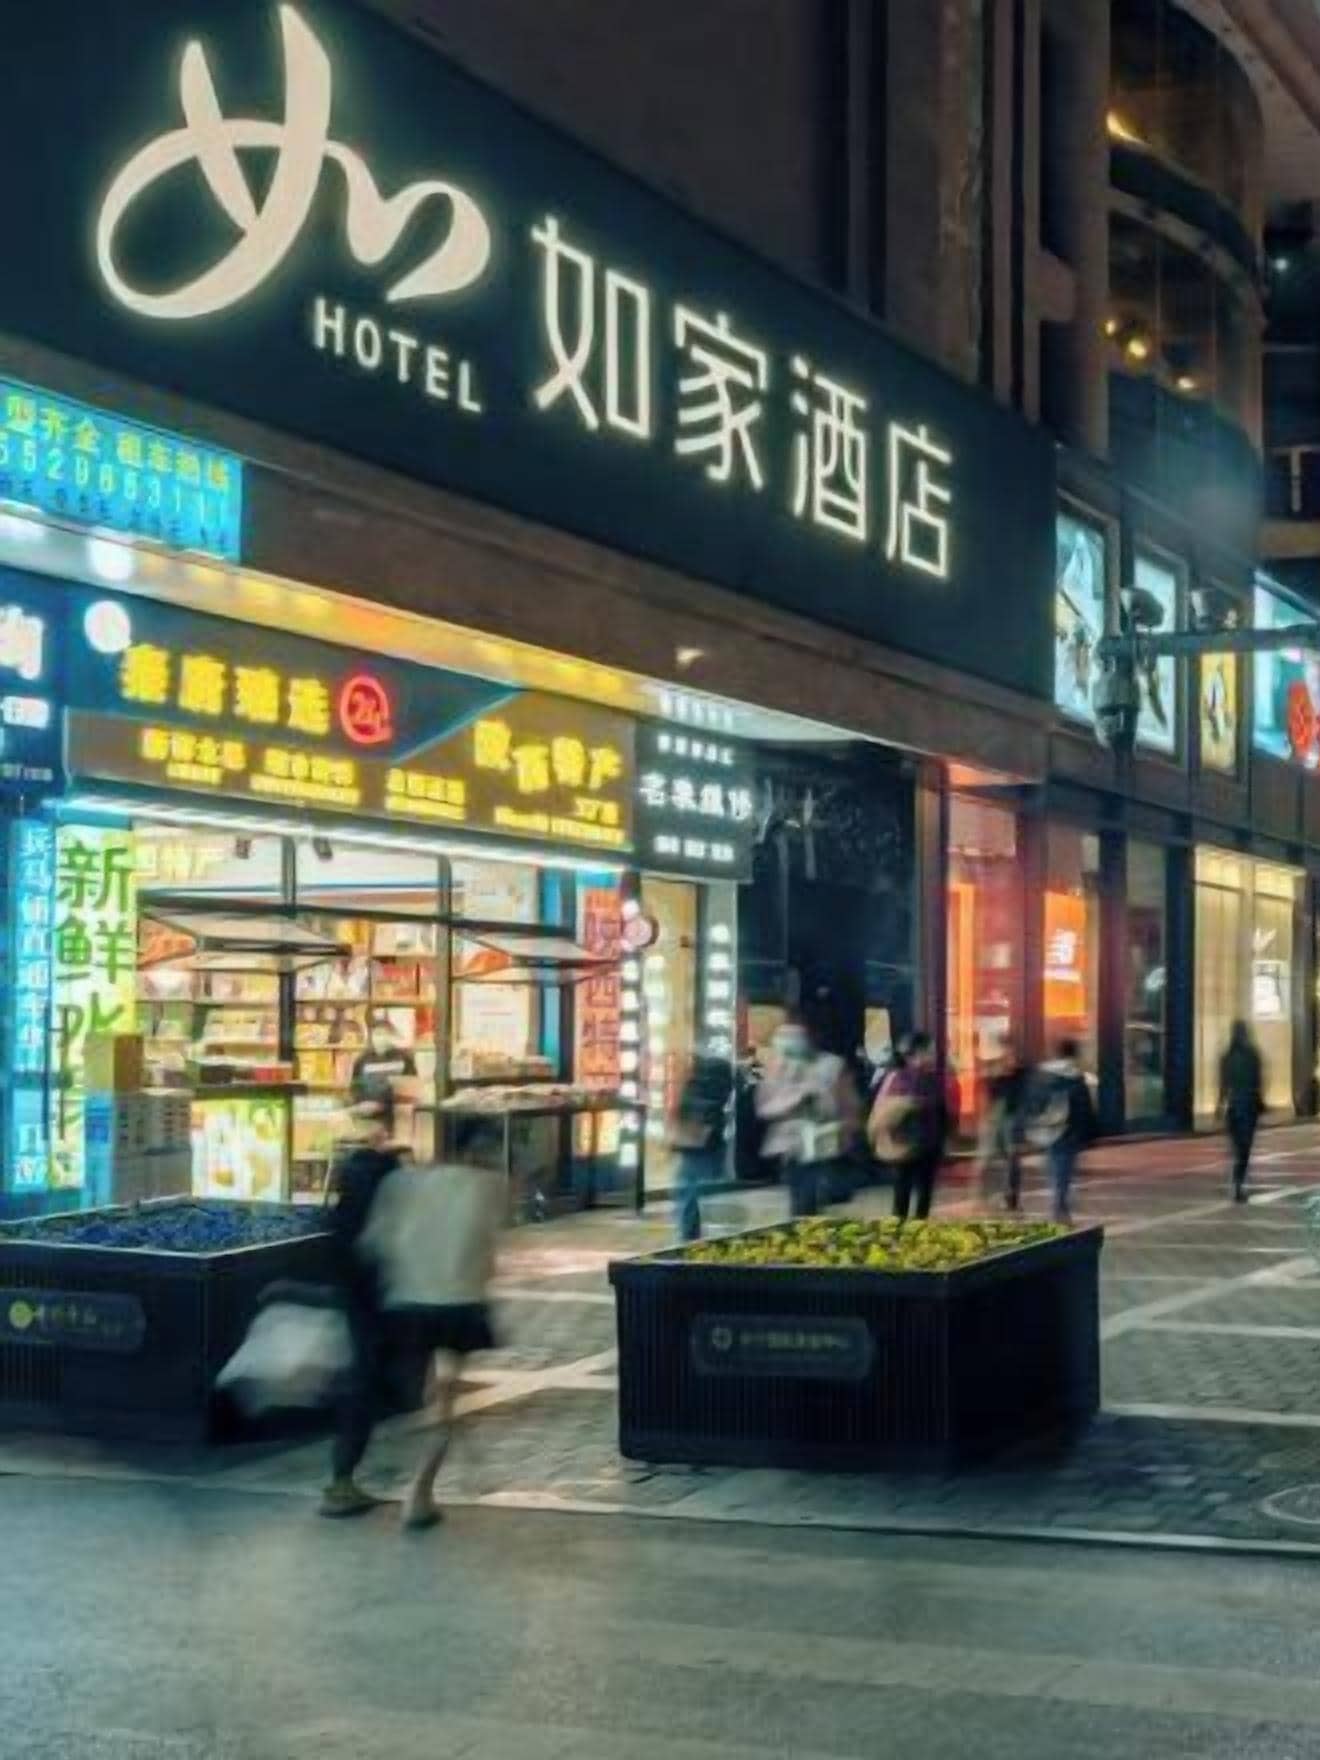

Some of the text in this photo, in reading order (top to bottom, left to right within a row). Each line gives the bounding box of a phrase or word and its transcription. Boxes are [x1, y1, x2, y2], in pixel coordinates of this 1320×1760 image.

[313, 297, 483, 414] HOTEL
[530, 215, 953, 581] 如家酒店
